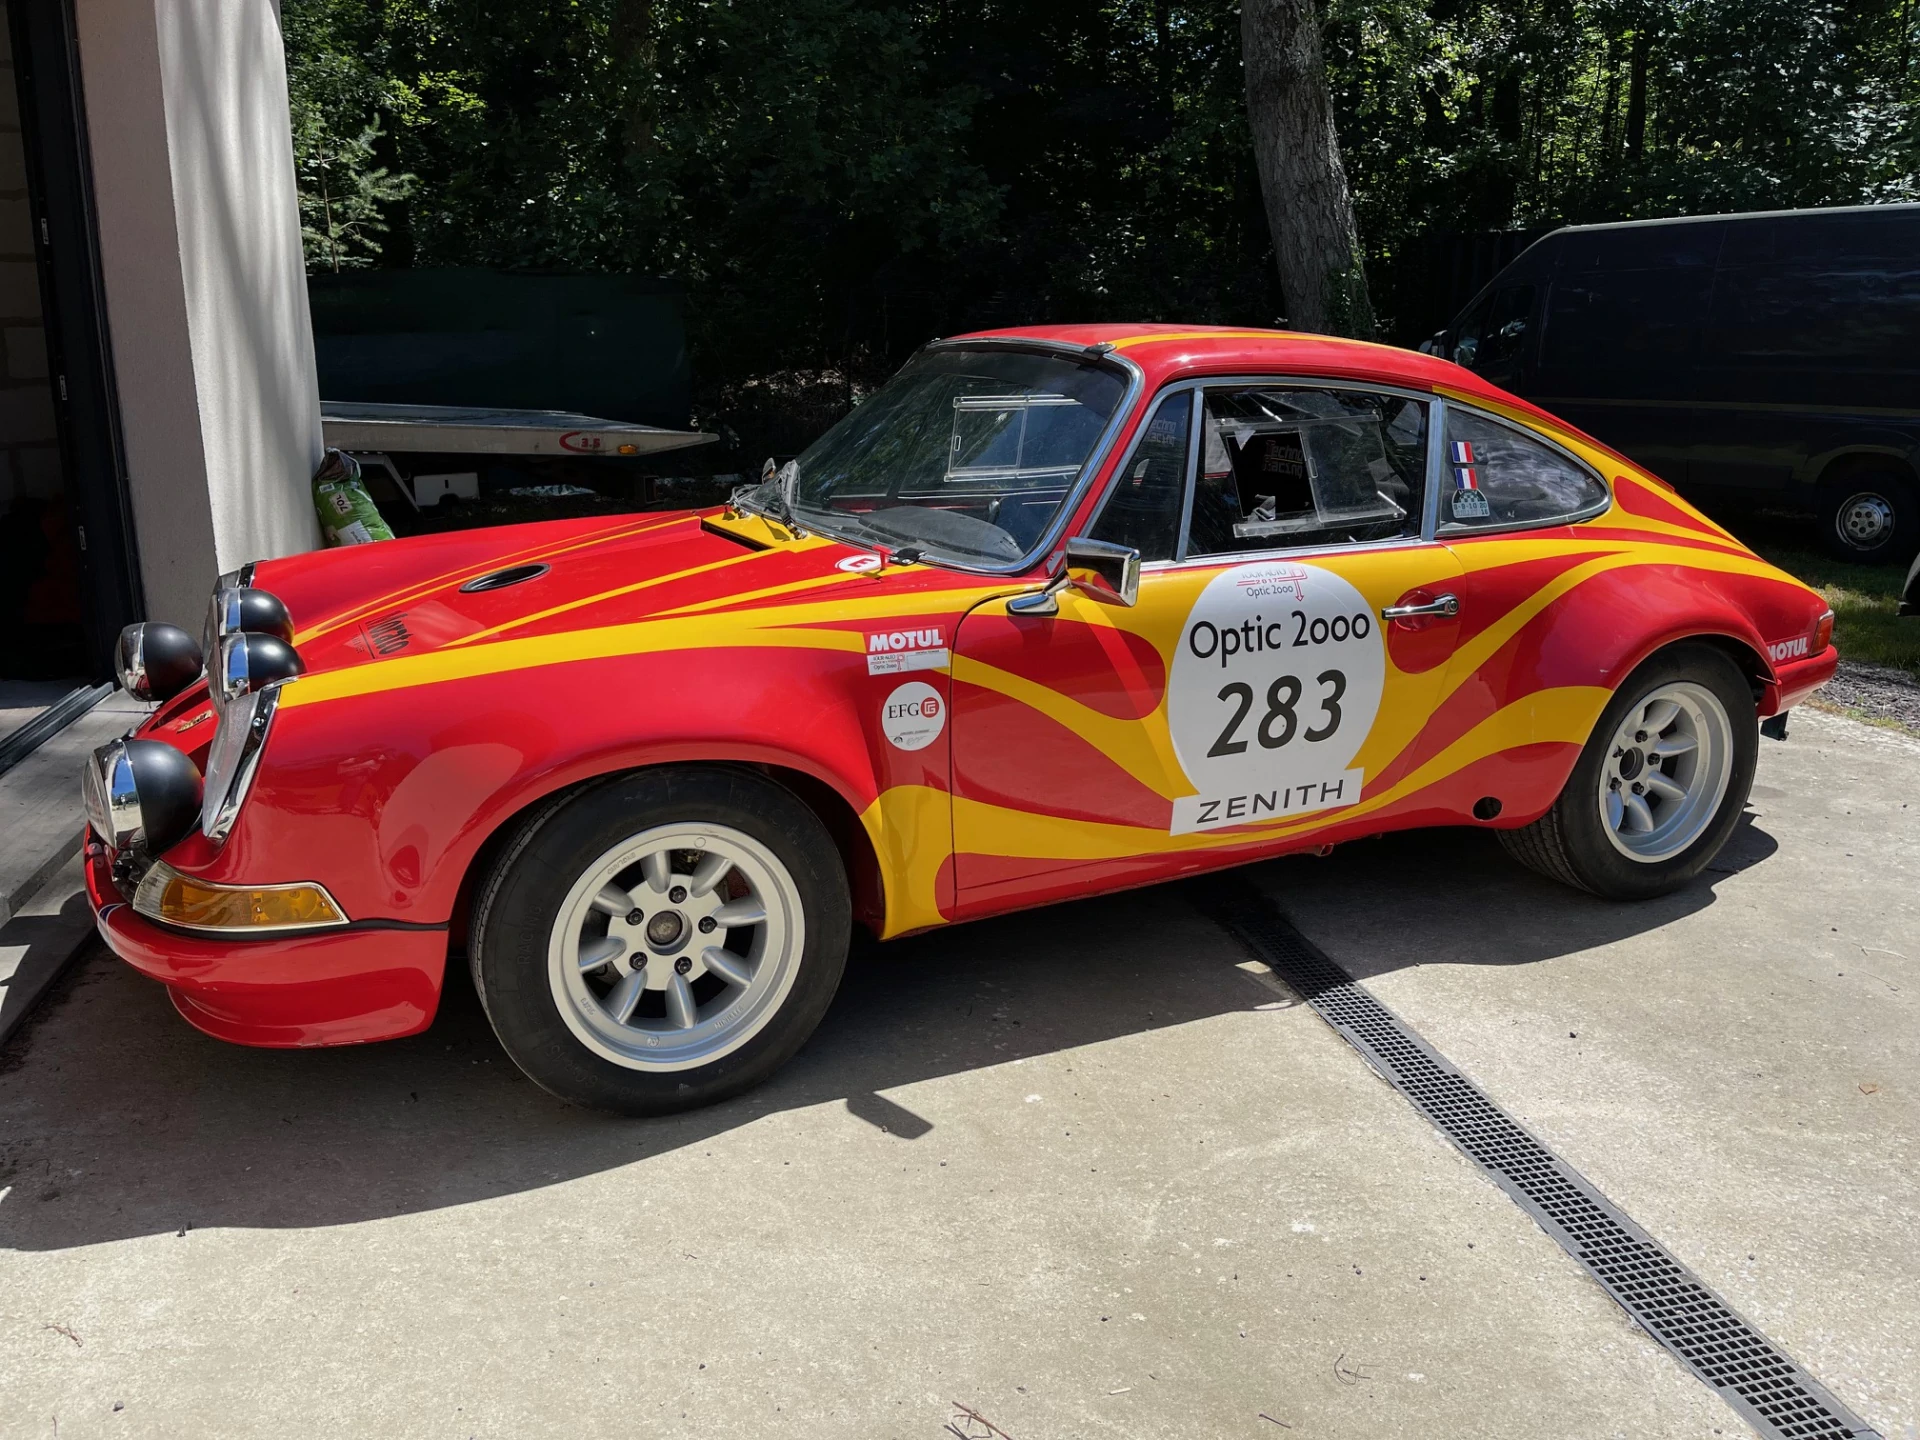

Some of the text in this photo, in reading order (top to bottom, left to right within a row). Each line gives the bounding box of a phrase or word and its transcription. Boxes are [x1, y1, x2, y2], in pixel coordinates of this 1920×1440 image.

[848, 557, 876, 568] E
[1246, 584, 1294, 599] Optic 2000
[869, 629, 943, 652] MOTUL
[1189, 610, 1370, 668] Optic 2000
[1767, 637, 1808, 662] MOTUL
[888, 702, 919, 718] EFG
[1207, 669, 1347, 758] 283
[1196, 779, 1344, 824] ZENITH
